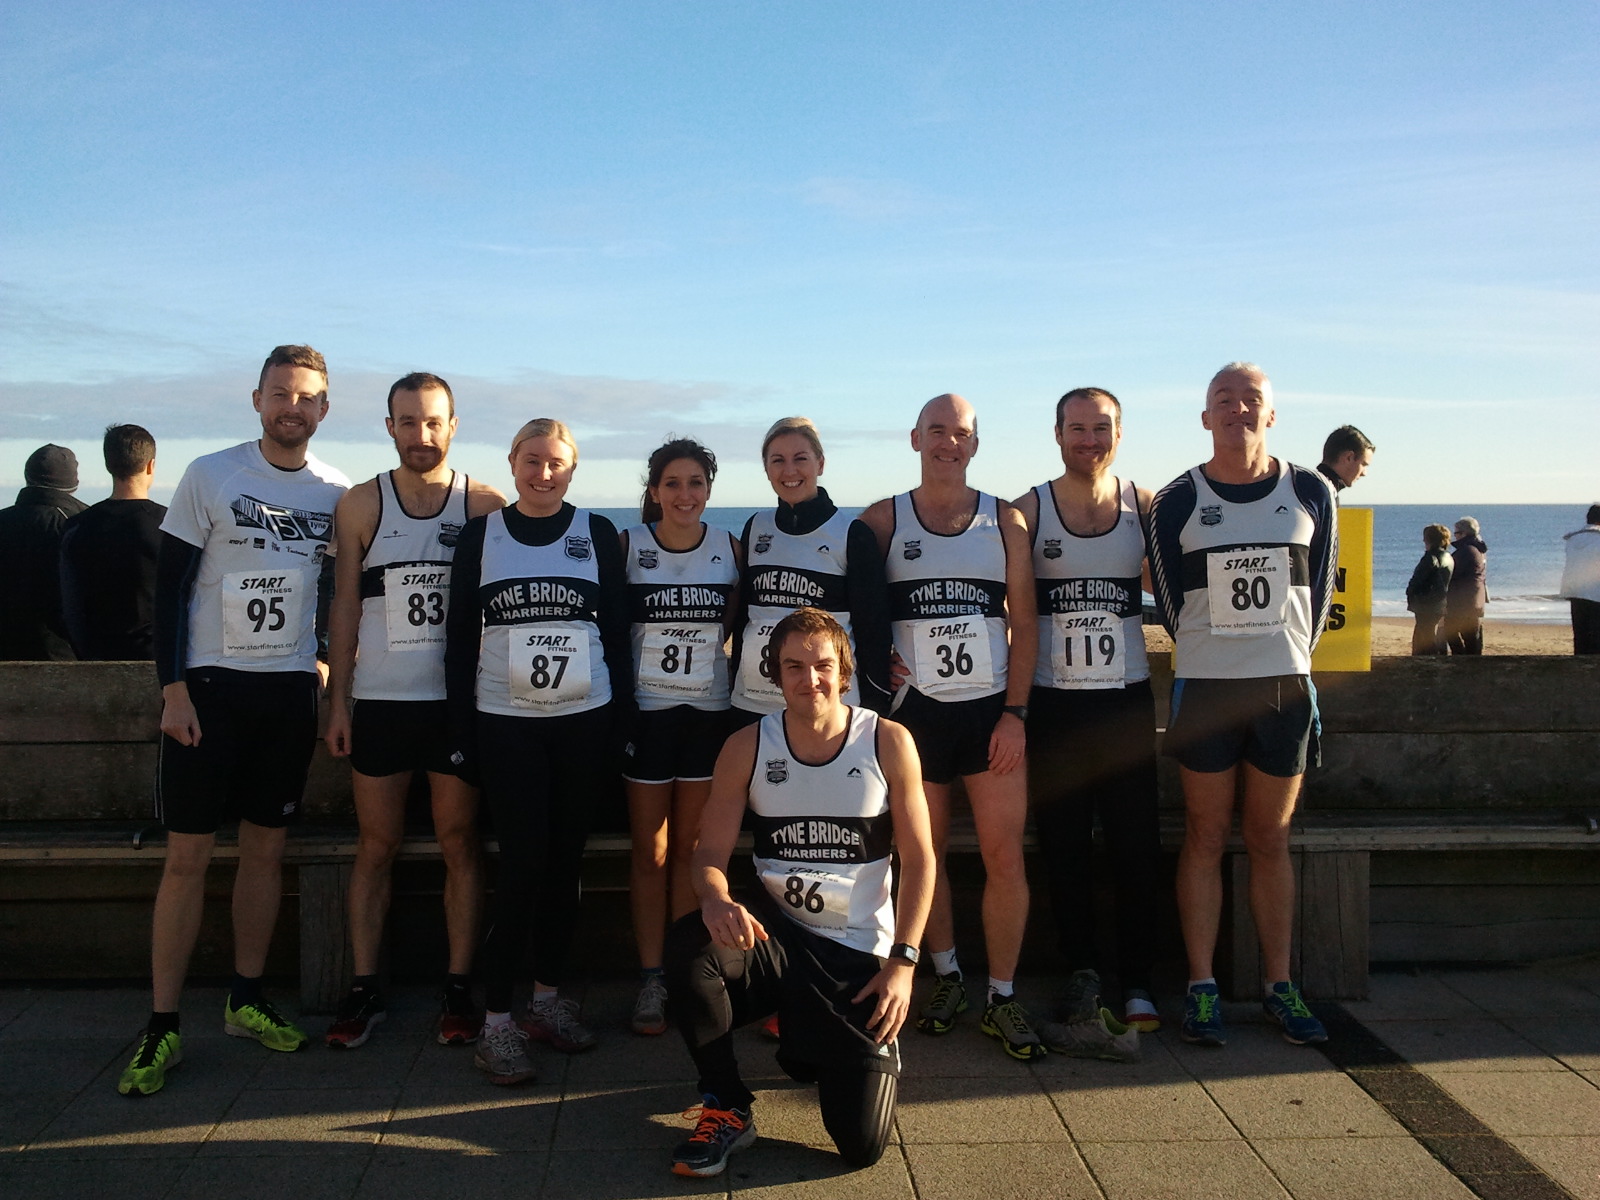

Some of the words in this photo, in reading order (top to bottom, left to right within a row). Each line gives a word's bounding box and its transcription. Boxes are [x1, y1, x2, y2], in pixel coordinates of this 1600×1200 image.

[1224, 556, 1270, 571] START
[1245, 566, 1277, 574] FITNESS
[240, 576, 286, 590] START
[401, 573, 445, 585] START
[753, 570, 778, 591] TYNE
[780, 571, 825, 598] BRIDGE
[490, 584, 526, 612] TYNE
[529, 582, 585, 608] BRIDGE
[644, 587, 679, 607] TYNE
[681, 586, 726, 606] BRIDGE
[909, 581, 943, 604] TYNE
[946, 580, 991, 605] BRIDGE
[1049, 580, 1083, 600] TYNE
[1086, 579, 1130, 603] BRIDGE
[1231, 575, 1271, 611] 80
[759, 593, 812, 607] HARRIERS
[1060, 601, 1122, 613] HARRIERS
[247, 596, 286, 633] 95
[408, 592, 445, 627] 83
[502, 606, 571, 620] HARRIERS
[655, 609, 717, 619] HARRIERS
[920, 604, 982, 615] HARRIERS
[929, 622, 970, 638] START
[1065, 616, 1107, 629] START
[526, 635, 571, 647] START
[661, 628, 702, 638] START
[948, 632, 977, 641] FITNESS
[1065, 634, 1115, 667] 119
[661, 644, 693, 675] 81
[936, 642, 973, 678] 36
[530, 654, 570, 690] 87
[771, 821, 806, 845] TYNE
[808, 820, 860, 846] BRIDGE
[783, 847, 848, 859] HARRIERS
[783, 875, 825, 914] 86
